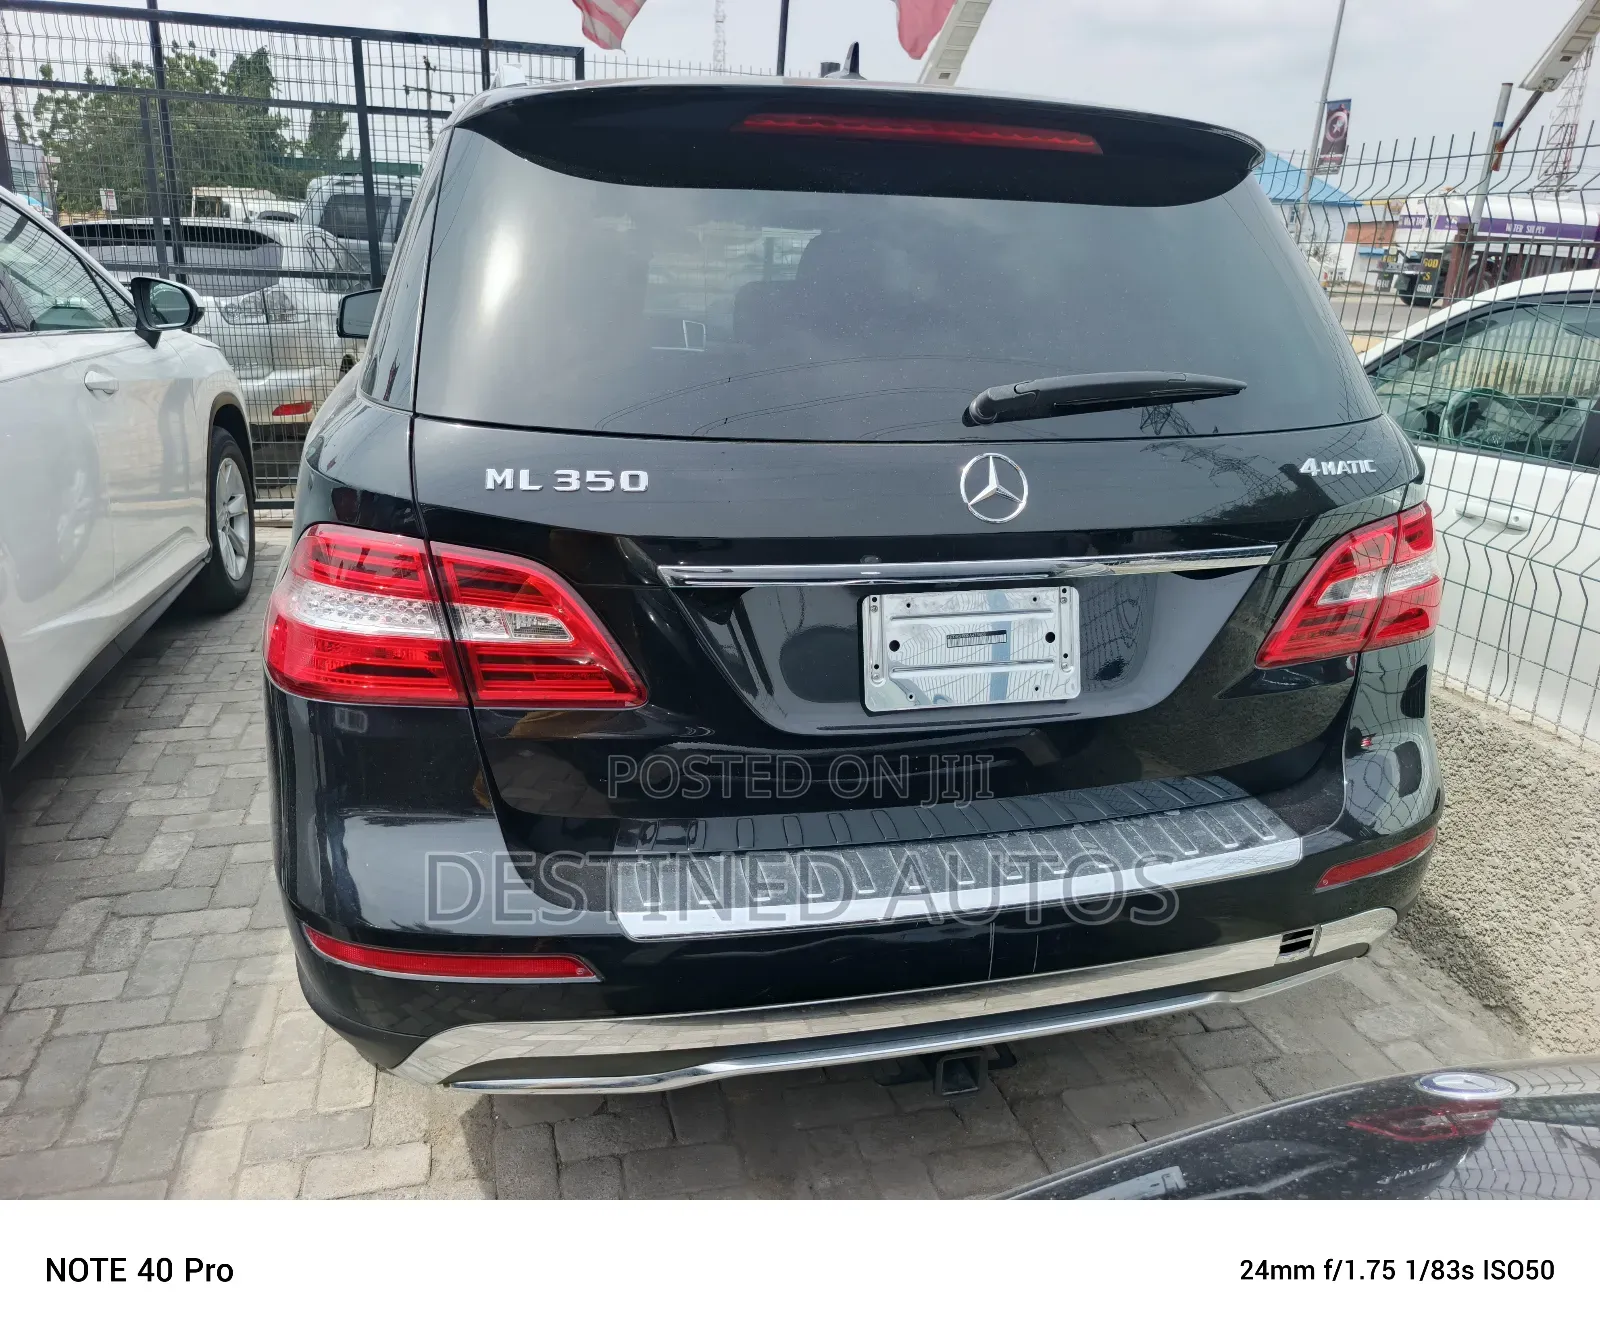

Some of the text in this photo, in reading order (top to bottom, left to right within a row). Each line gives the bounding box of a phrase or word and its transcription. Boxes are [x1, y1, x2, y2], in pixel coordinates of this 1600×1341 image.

[1423, 257, 1439, 268] GOD
[1416, 283, 1433, 294] GREAT
[485, 468, 649, 492] ML 350
